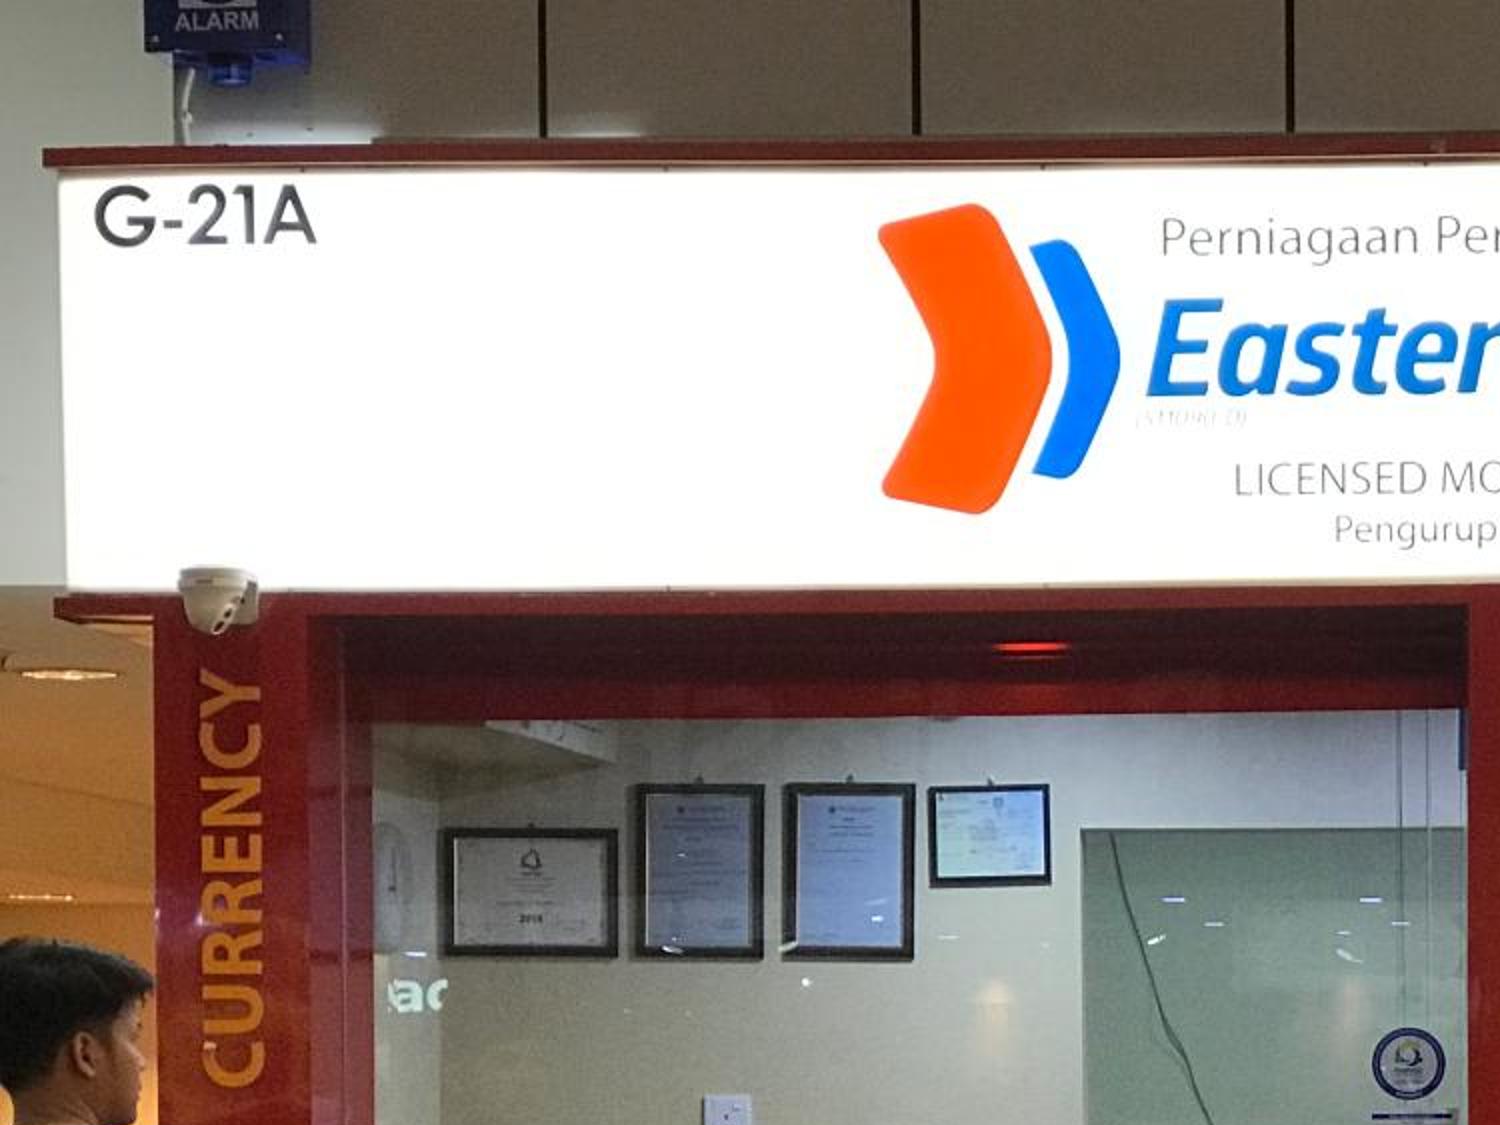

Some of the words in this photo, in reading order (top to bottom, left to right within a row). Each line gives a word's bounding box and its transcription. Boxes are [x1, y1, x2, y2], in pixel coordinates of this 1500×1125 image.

[174, 10, 259, 32] ALARM
[94, 184, 317, 248] G-21A
[1162, 218, 1418, 266] Perniagaan
[1235, 461, 1428, 496] LICENSED
[1335, 515, 1497, 550] Pengurup
[199, 668, 265, 1088] CURRENCY
